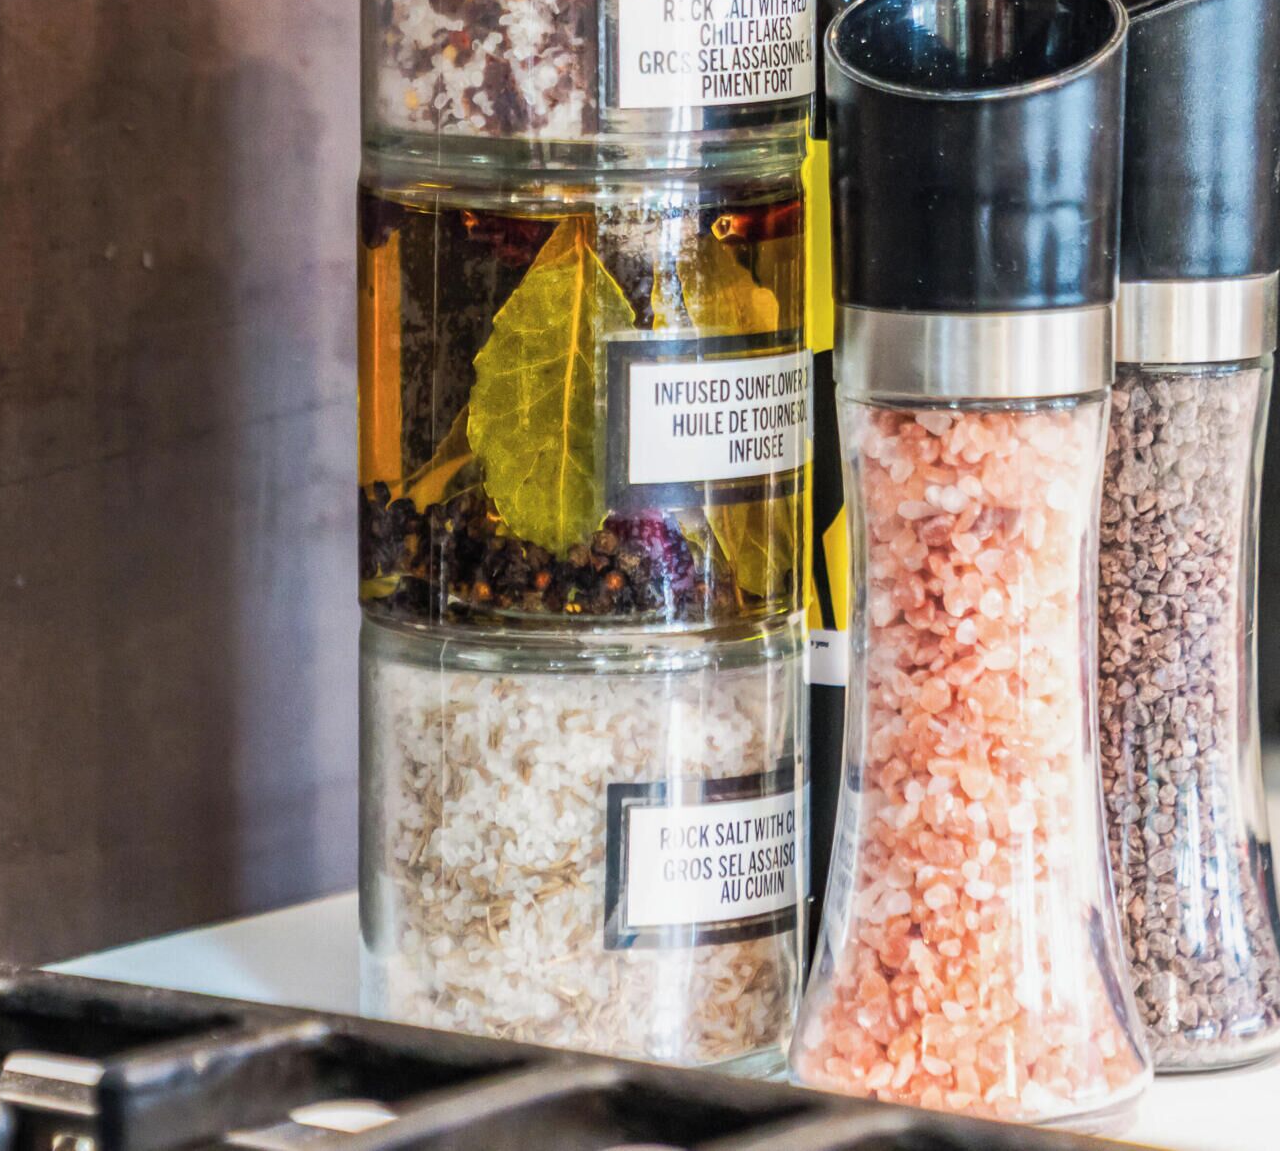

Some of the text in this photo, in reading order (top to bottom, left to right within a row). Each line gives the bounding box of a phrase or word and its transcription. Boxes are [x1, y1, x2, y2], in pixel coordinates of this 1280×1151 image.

[700, 16, 792, 47] CHILI FLAKES
[698, 47, 729, 73] SEL
[732, 33, 805, 71] ASSAISONNÉ
[702, 67, 793, 99] PIMENT FORT
[654, 378, 730, 406] INFUSED
[735, 370, 803, 401] SUNFLOWER
[673, 411, 724, 437] HUILE
[729, 408, 748, 434] DE
[729, 428, 784, 464] INFUSÉE
[715, 819, 751, 847] SALT
[754, 813, 784, 842] WITH
[663, 856, 713, 882] GROS
[719, 853, 745, 879] SEL
[720, 868, 785, 905] AU CUMIN
